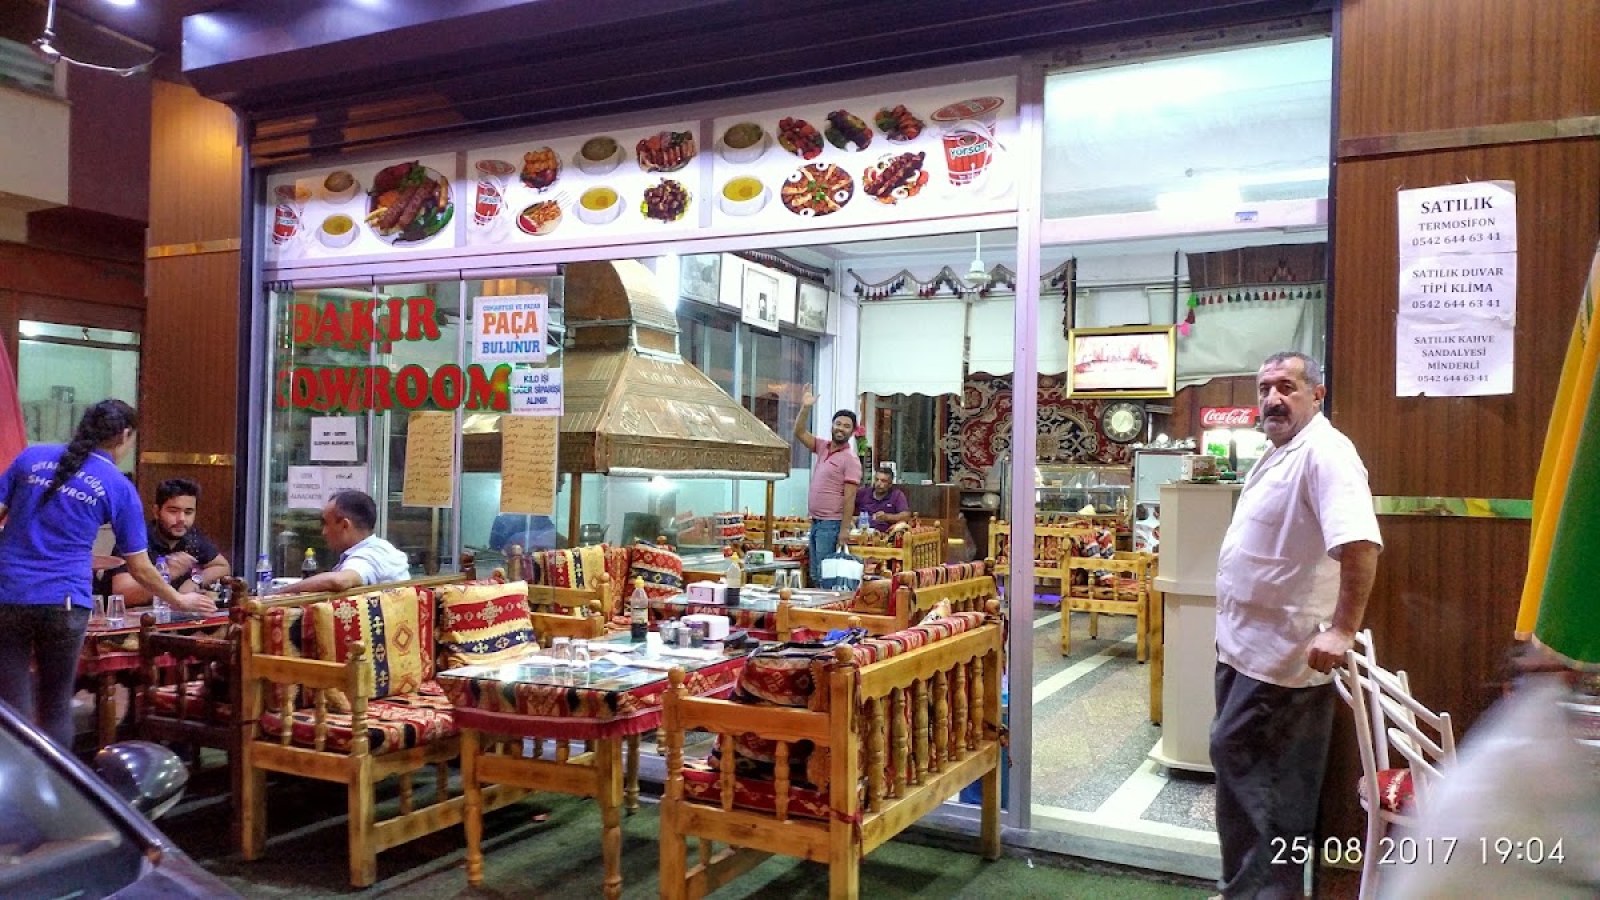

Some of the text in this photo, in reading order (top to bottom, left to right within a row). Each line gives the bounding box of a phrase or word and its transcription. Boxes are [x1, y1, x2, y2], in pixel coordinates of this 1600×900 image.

[1420, 197, 1493, 215] SATILIK
[1418, 217, 1496, 232] TERMOSİFON
[1411, 232, 1501, 247] 0542 644 63 41
[1412, 267, 1504, 279] SATILIK DUVAR
[1421, 283, 1493, 294] TİPİ KLİMA
[1411, 299, 1501, 309] 0542 644 63 41
[482, 311, 539, 340] PAÇA
[1414, 335, 1495, 345] SATILIK KAHVE
[482, 340, 541, 354] BULUNUR
[1421, 347, 1486, 357] SANDALYESİ
[1427, 360, 1480, 370] MİNDERLİ
[1417, 375, 1441, 383] 0542
